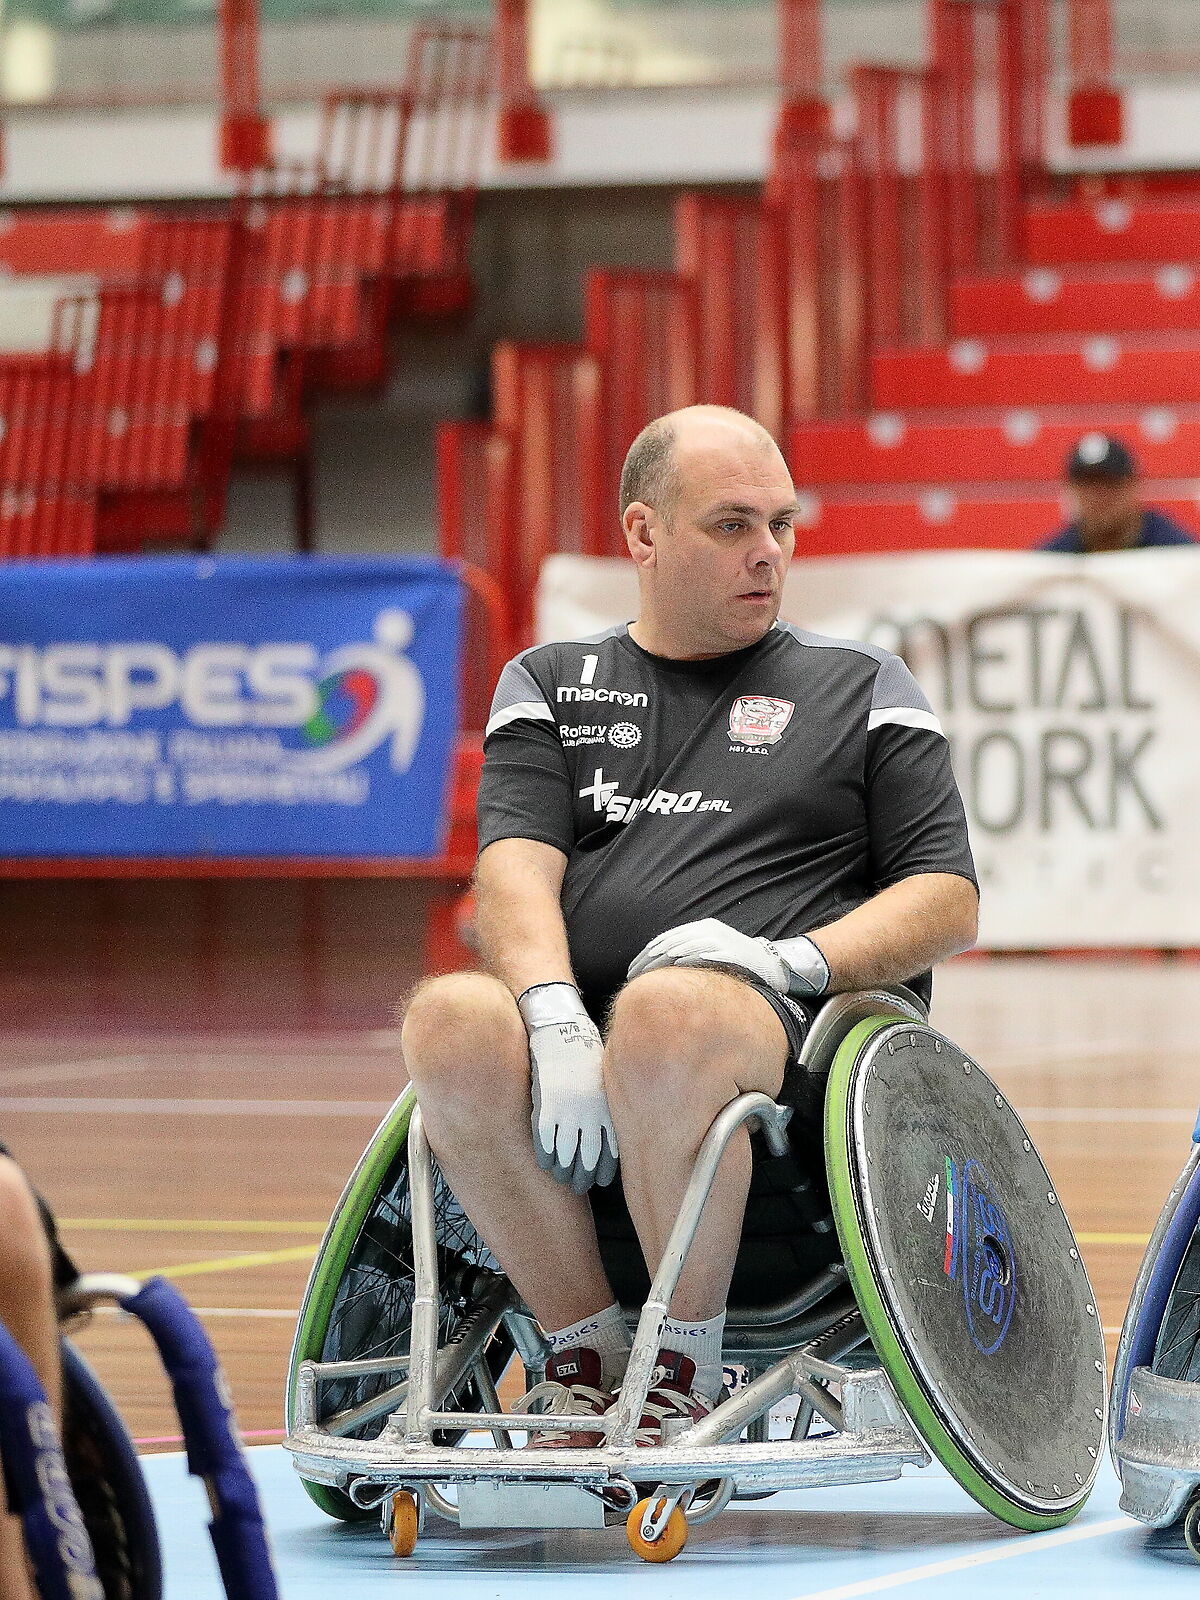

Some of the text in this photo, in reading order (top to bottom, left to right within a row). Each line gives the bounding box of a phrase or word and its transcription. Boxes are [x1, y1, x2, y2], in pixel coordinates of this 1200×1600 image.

[580, 653, 599, 685] 1
[556, 686, 649, 708] macron
[559, 724, 607, 739] Rotary
[962, 727, 1168, 836] ORK
[696, 800, 733, 812] SRL
[557, 1365, 577, 1376] 574
